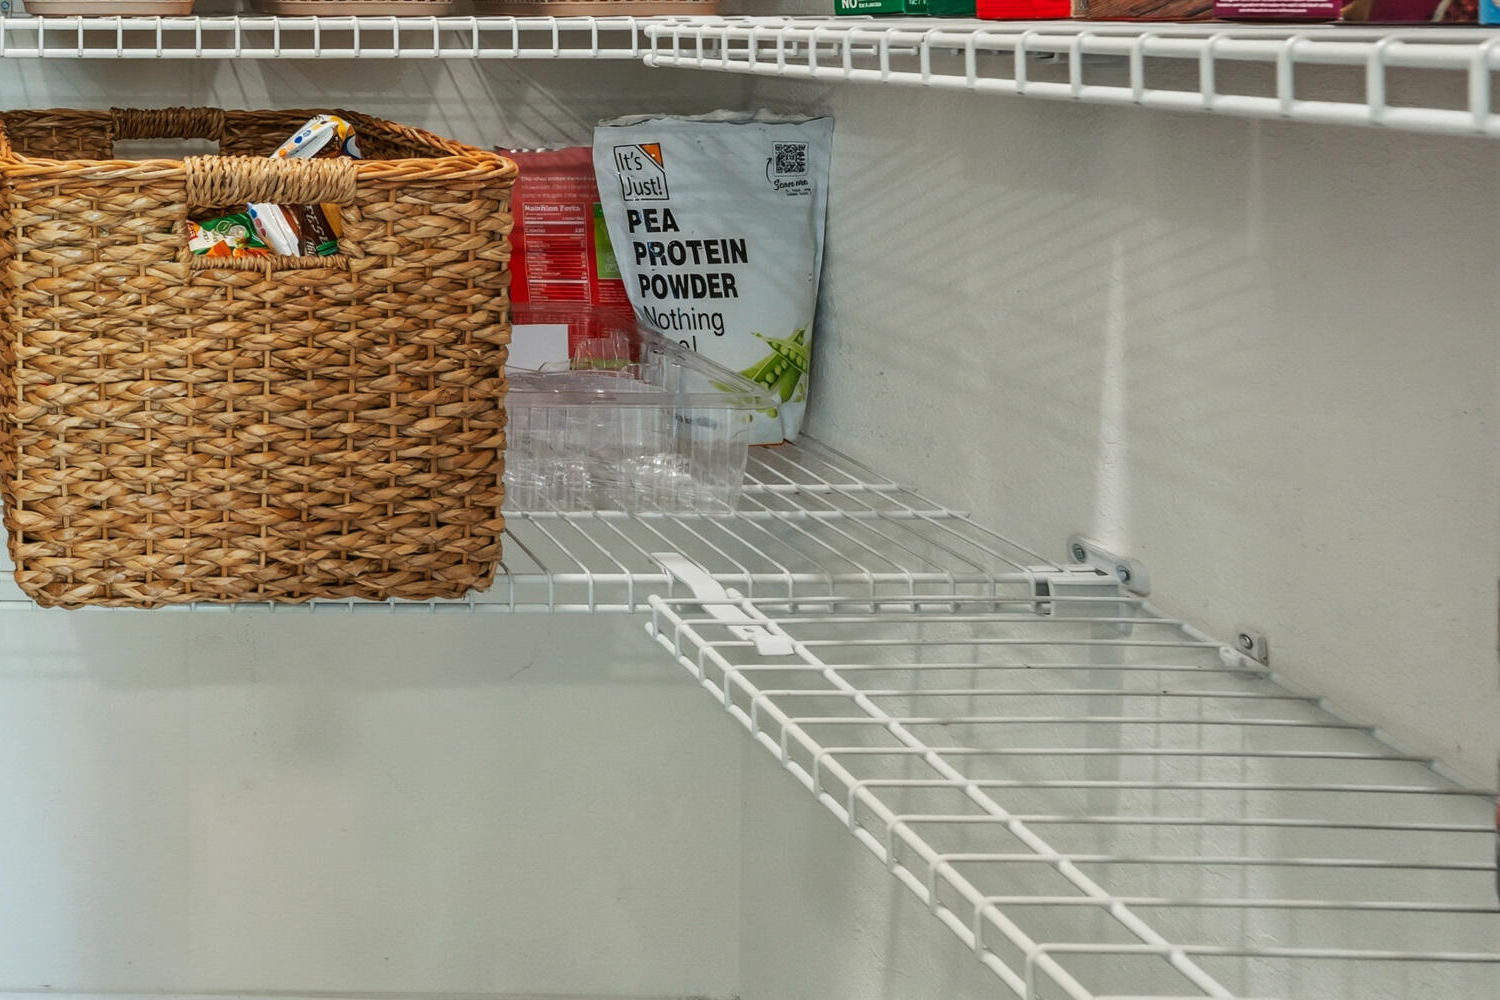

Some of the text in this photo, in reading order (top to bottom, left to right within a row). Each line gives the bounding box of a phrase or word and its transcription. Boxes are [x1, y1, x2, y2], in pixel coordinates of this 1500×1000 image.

[618, 151, 644, 172] It's
[625, 175, 664, 198] Just!
[627, 207, 681, 234] PEA
[633, 238, 749, 267] PROTEIN
[638, 272, 740, 300] POWDER
[643, 304, 726, 337] Nothing
